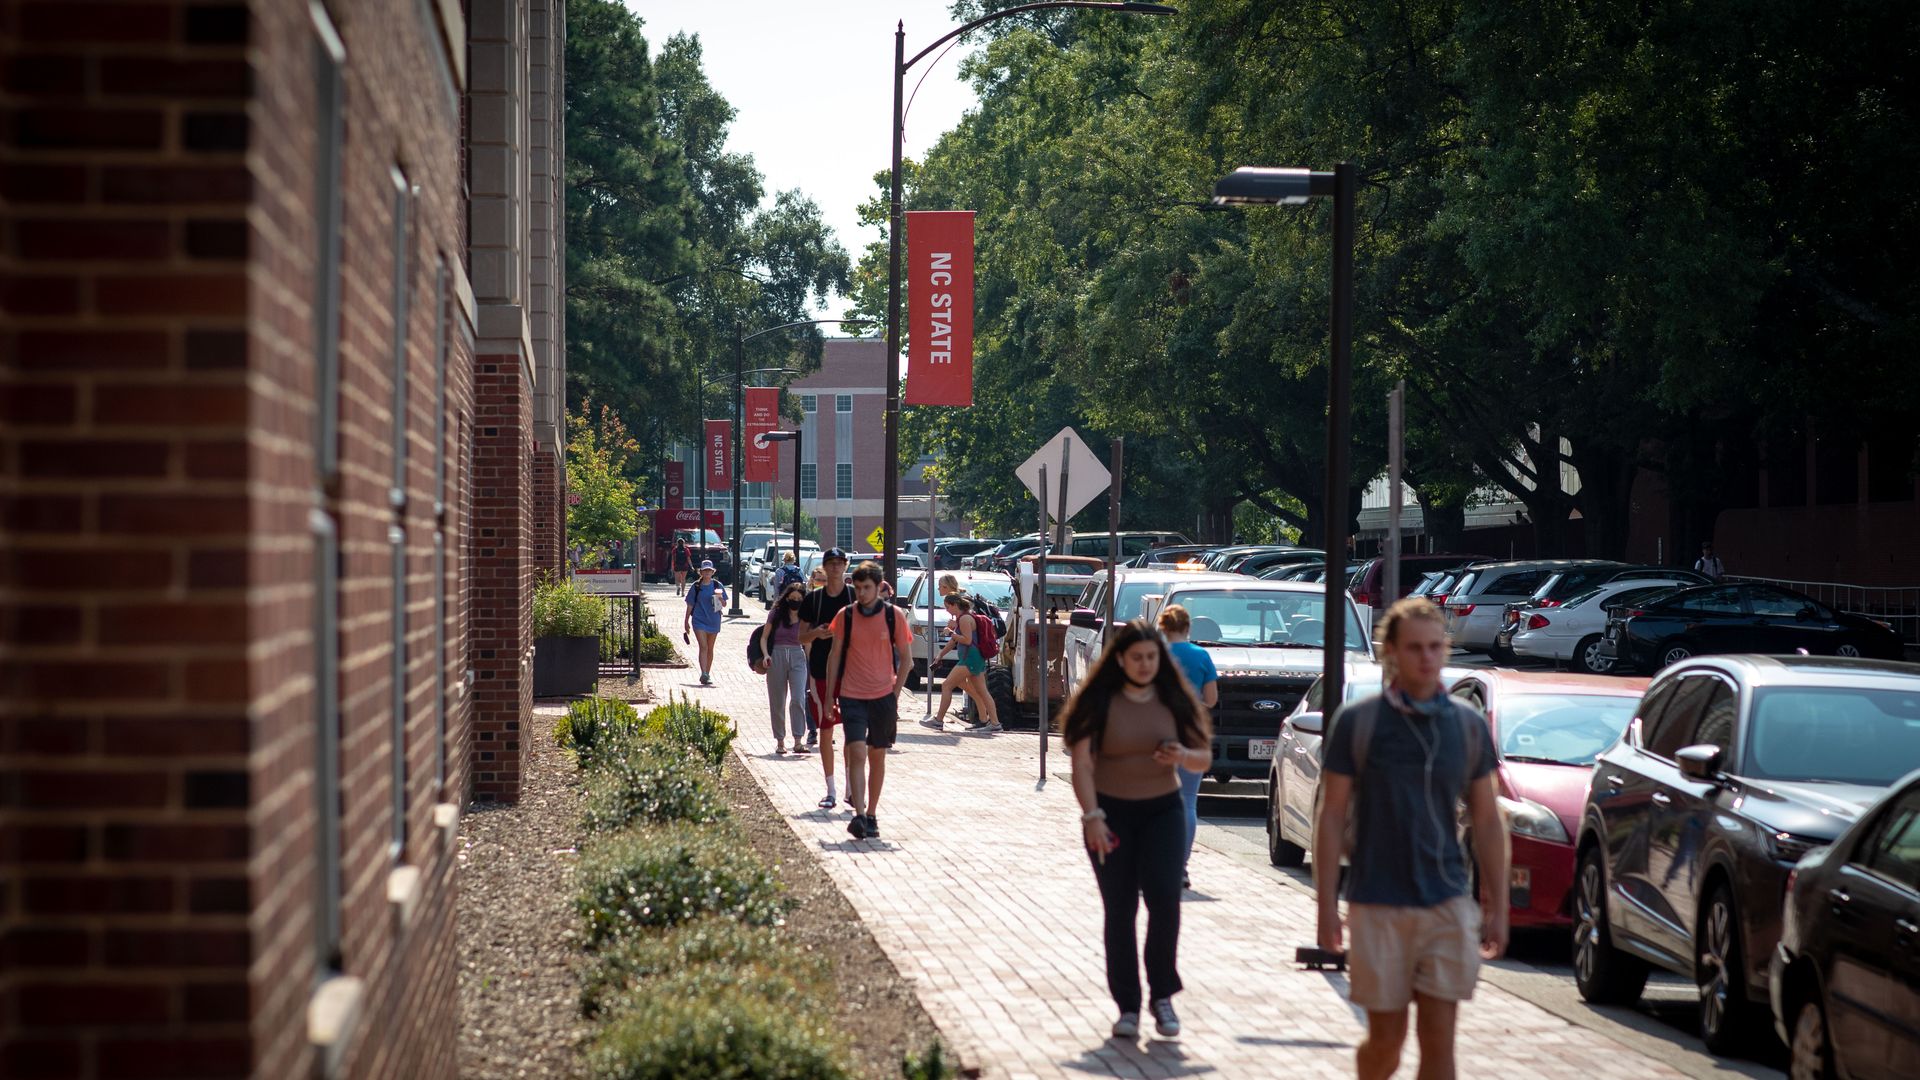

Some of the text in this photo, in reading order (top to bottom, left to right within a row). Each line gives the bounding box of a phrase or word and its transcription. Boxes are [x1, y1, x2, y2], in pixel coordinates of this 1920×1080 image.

[930, 252, 952, 365] NC STATE
[714, 434, 724, 476] NC STATE
